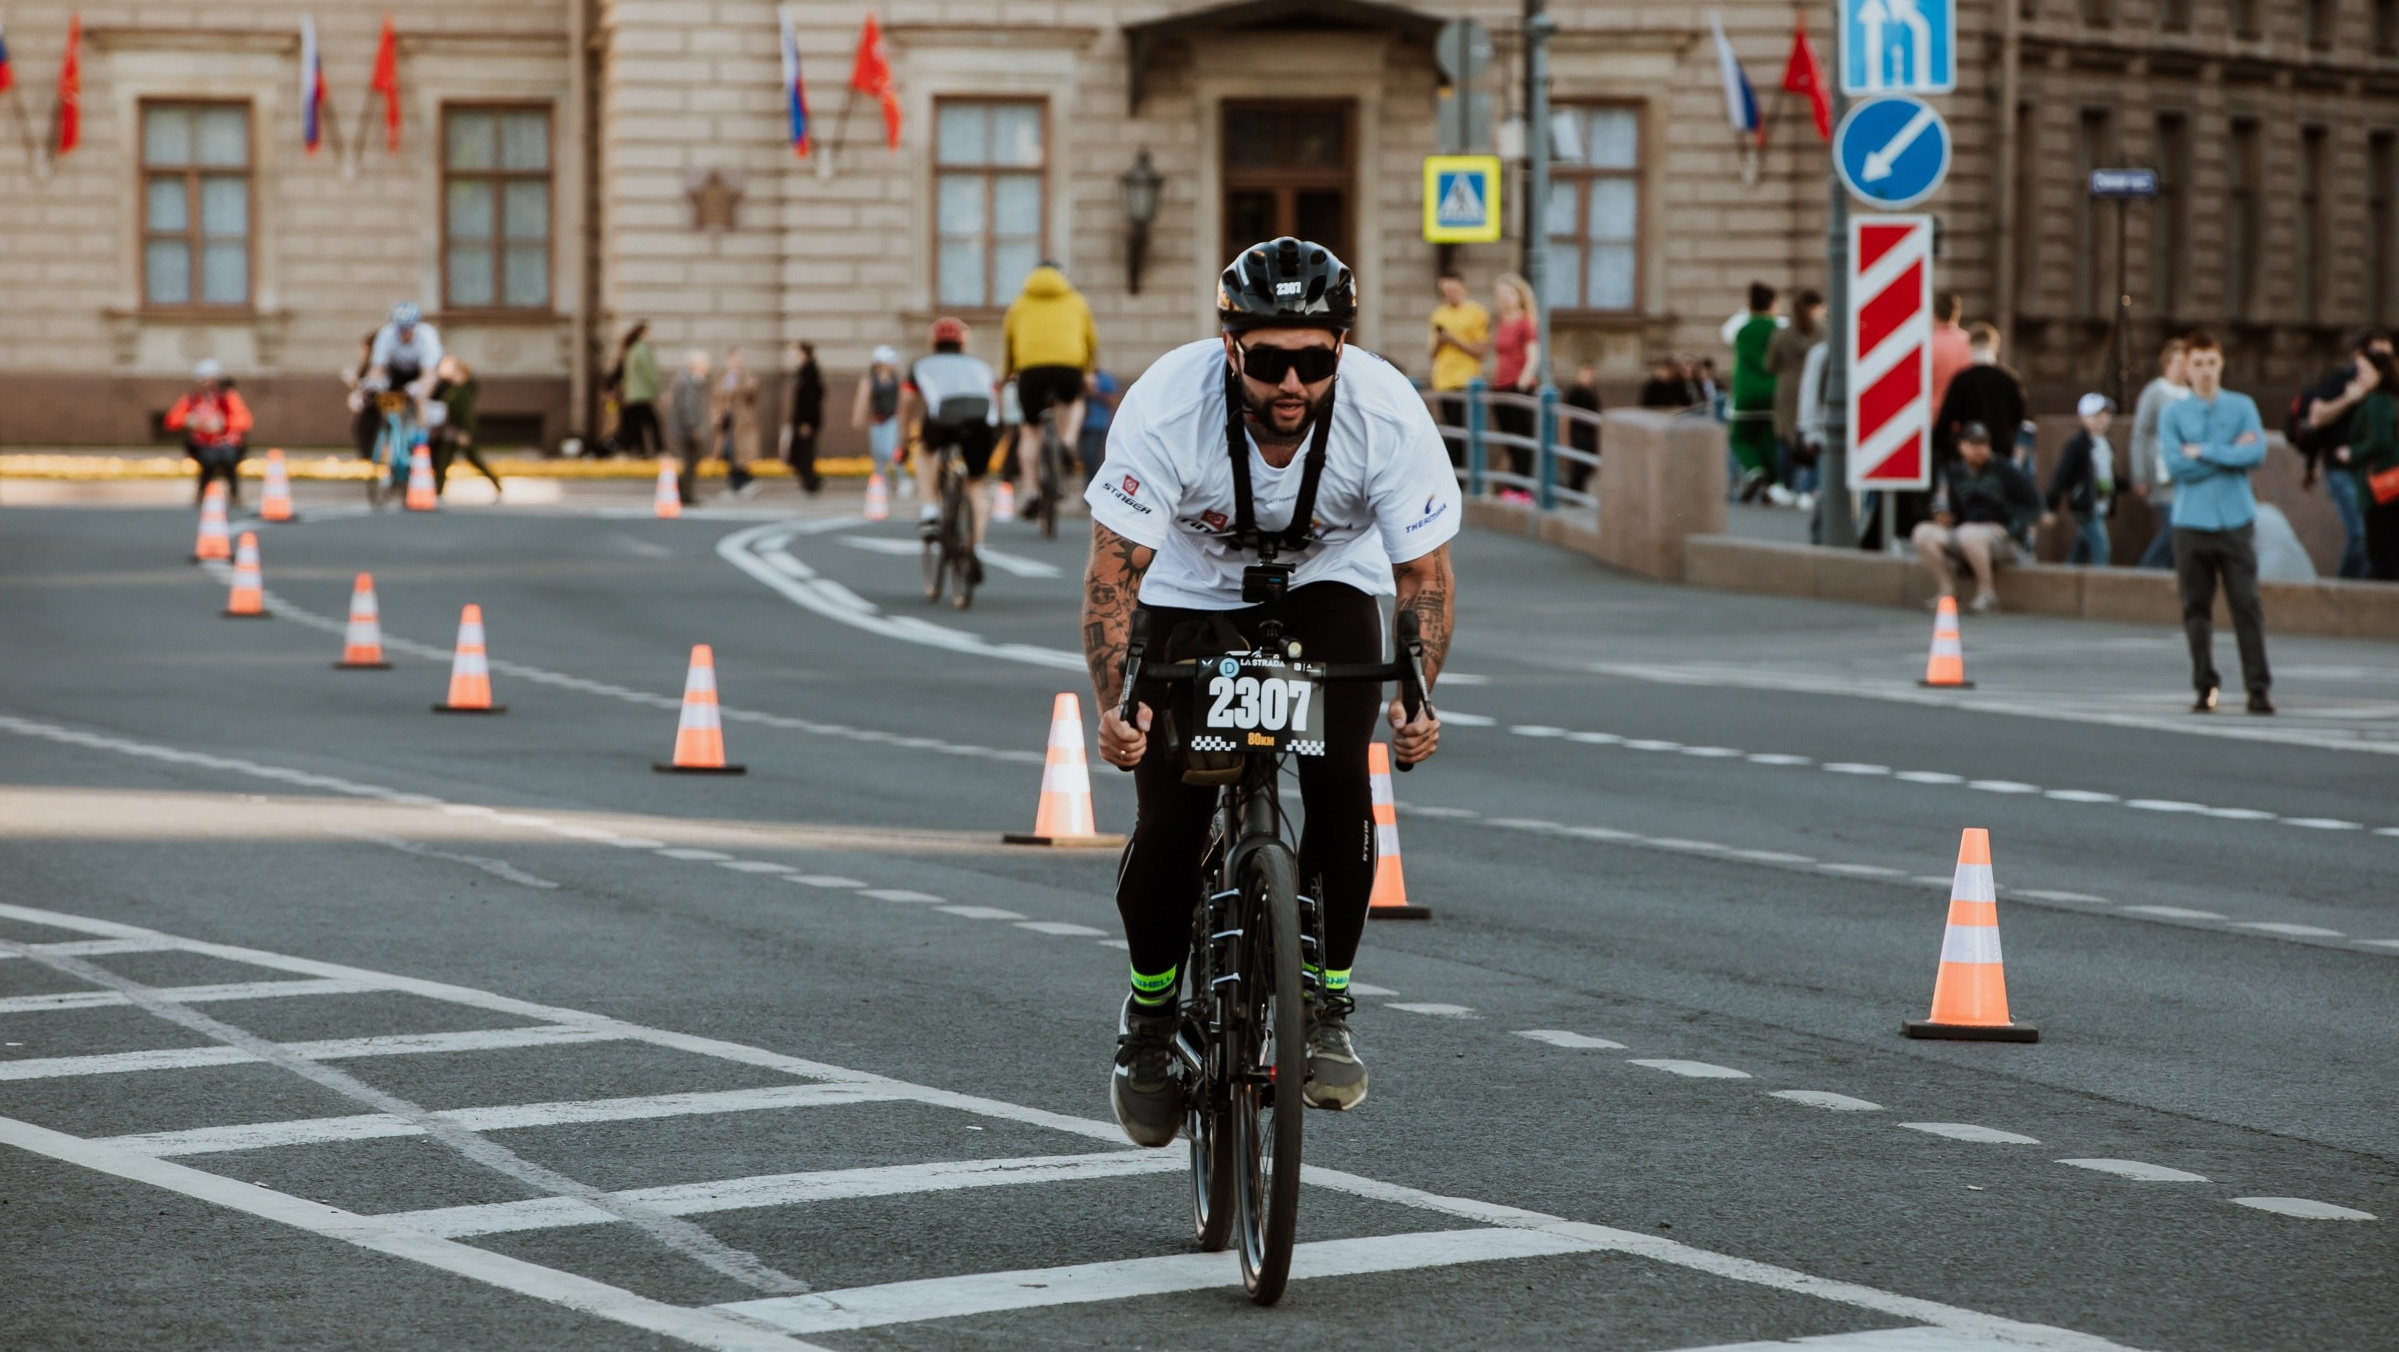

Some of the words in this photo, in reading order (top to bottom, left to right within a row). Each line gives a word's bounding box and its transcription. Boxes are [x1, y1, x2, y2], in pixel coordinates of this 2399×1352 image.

[1275, 281, 1302, 296] 2307
[1102, 482, 1152, 515] STINGER
[1240, 658, 1251, 666] LA
[1251, 658, 1286, 668] STRADA
[1206, 676, 1312, 732] 2307
